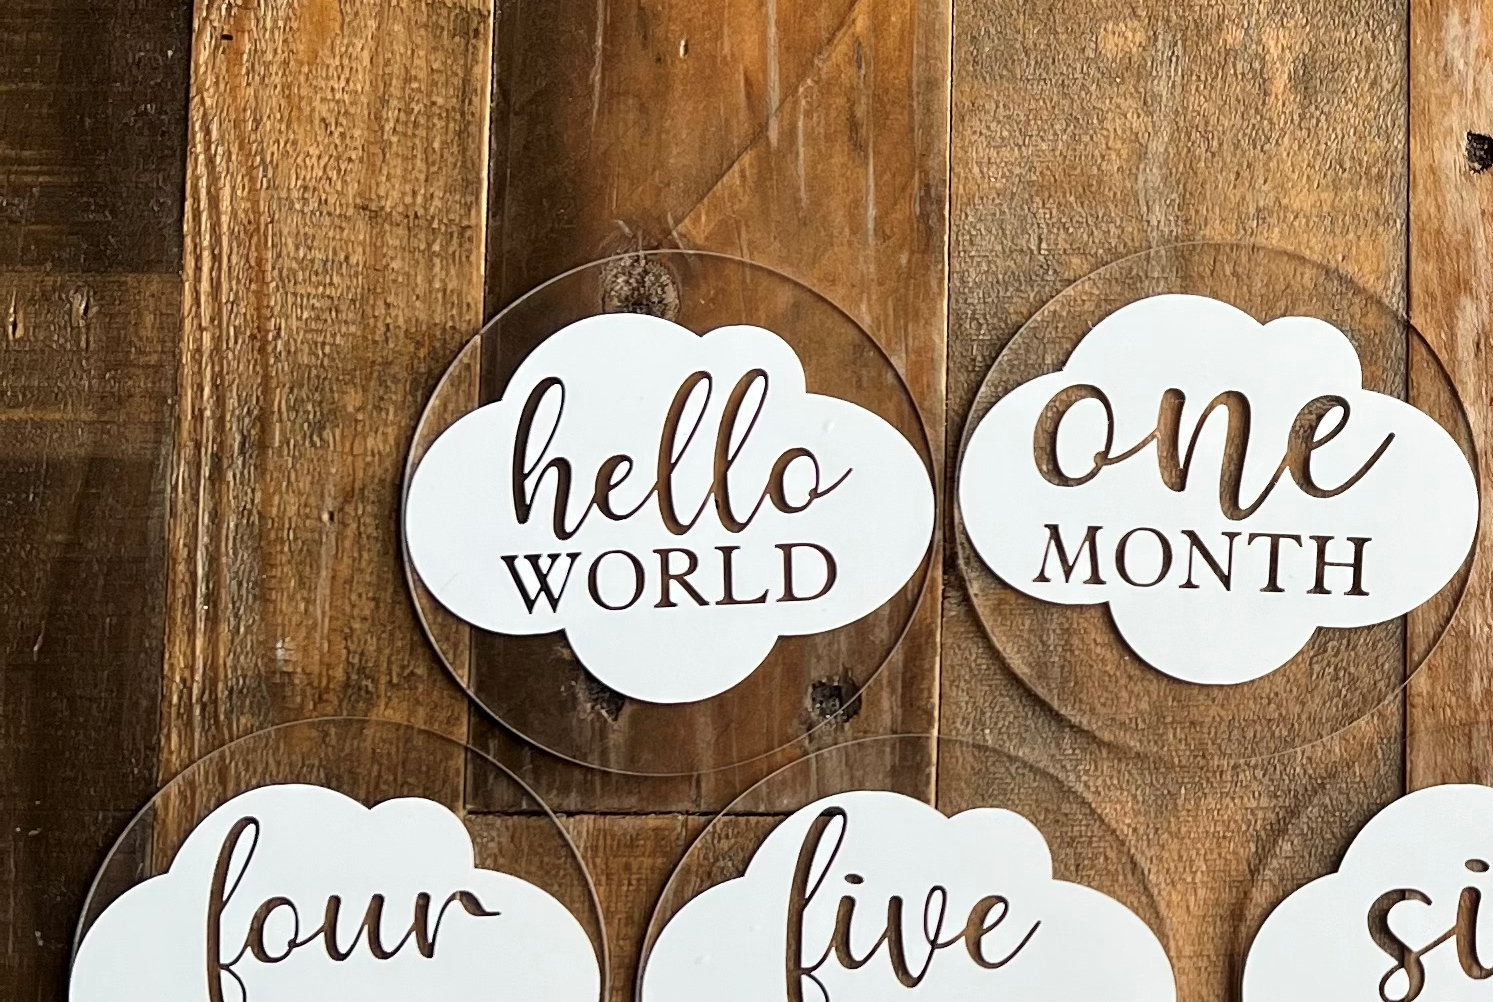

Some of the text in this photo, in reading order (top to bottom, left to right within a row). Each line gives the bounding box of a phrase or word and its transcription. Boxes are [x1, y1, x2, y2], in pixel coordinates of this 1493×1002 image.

[512, 368, 852, 540] hello
[1034, 384, 1395, 521] one
[501, 543, 837, 614] WORLD
[1033, 524, 1372, 596] MONTH
